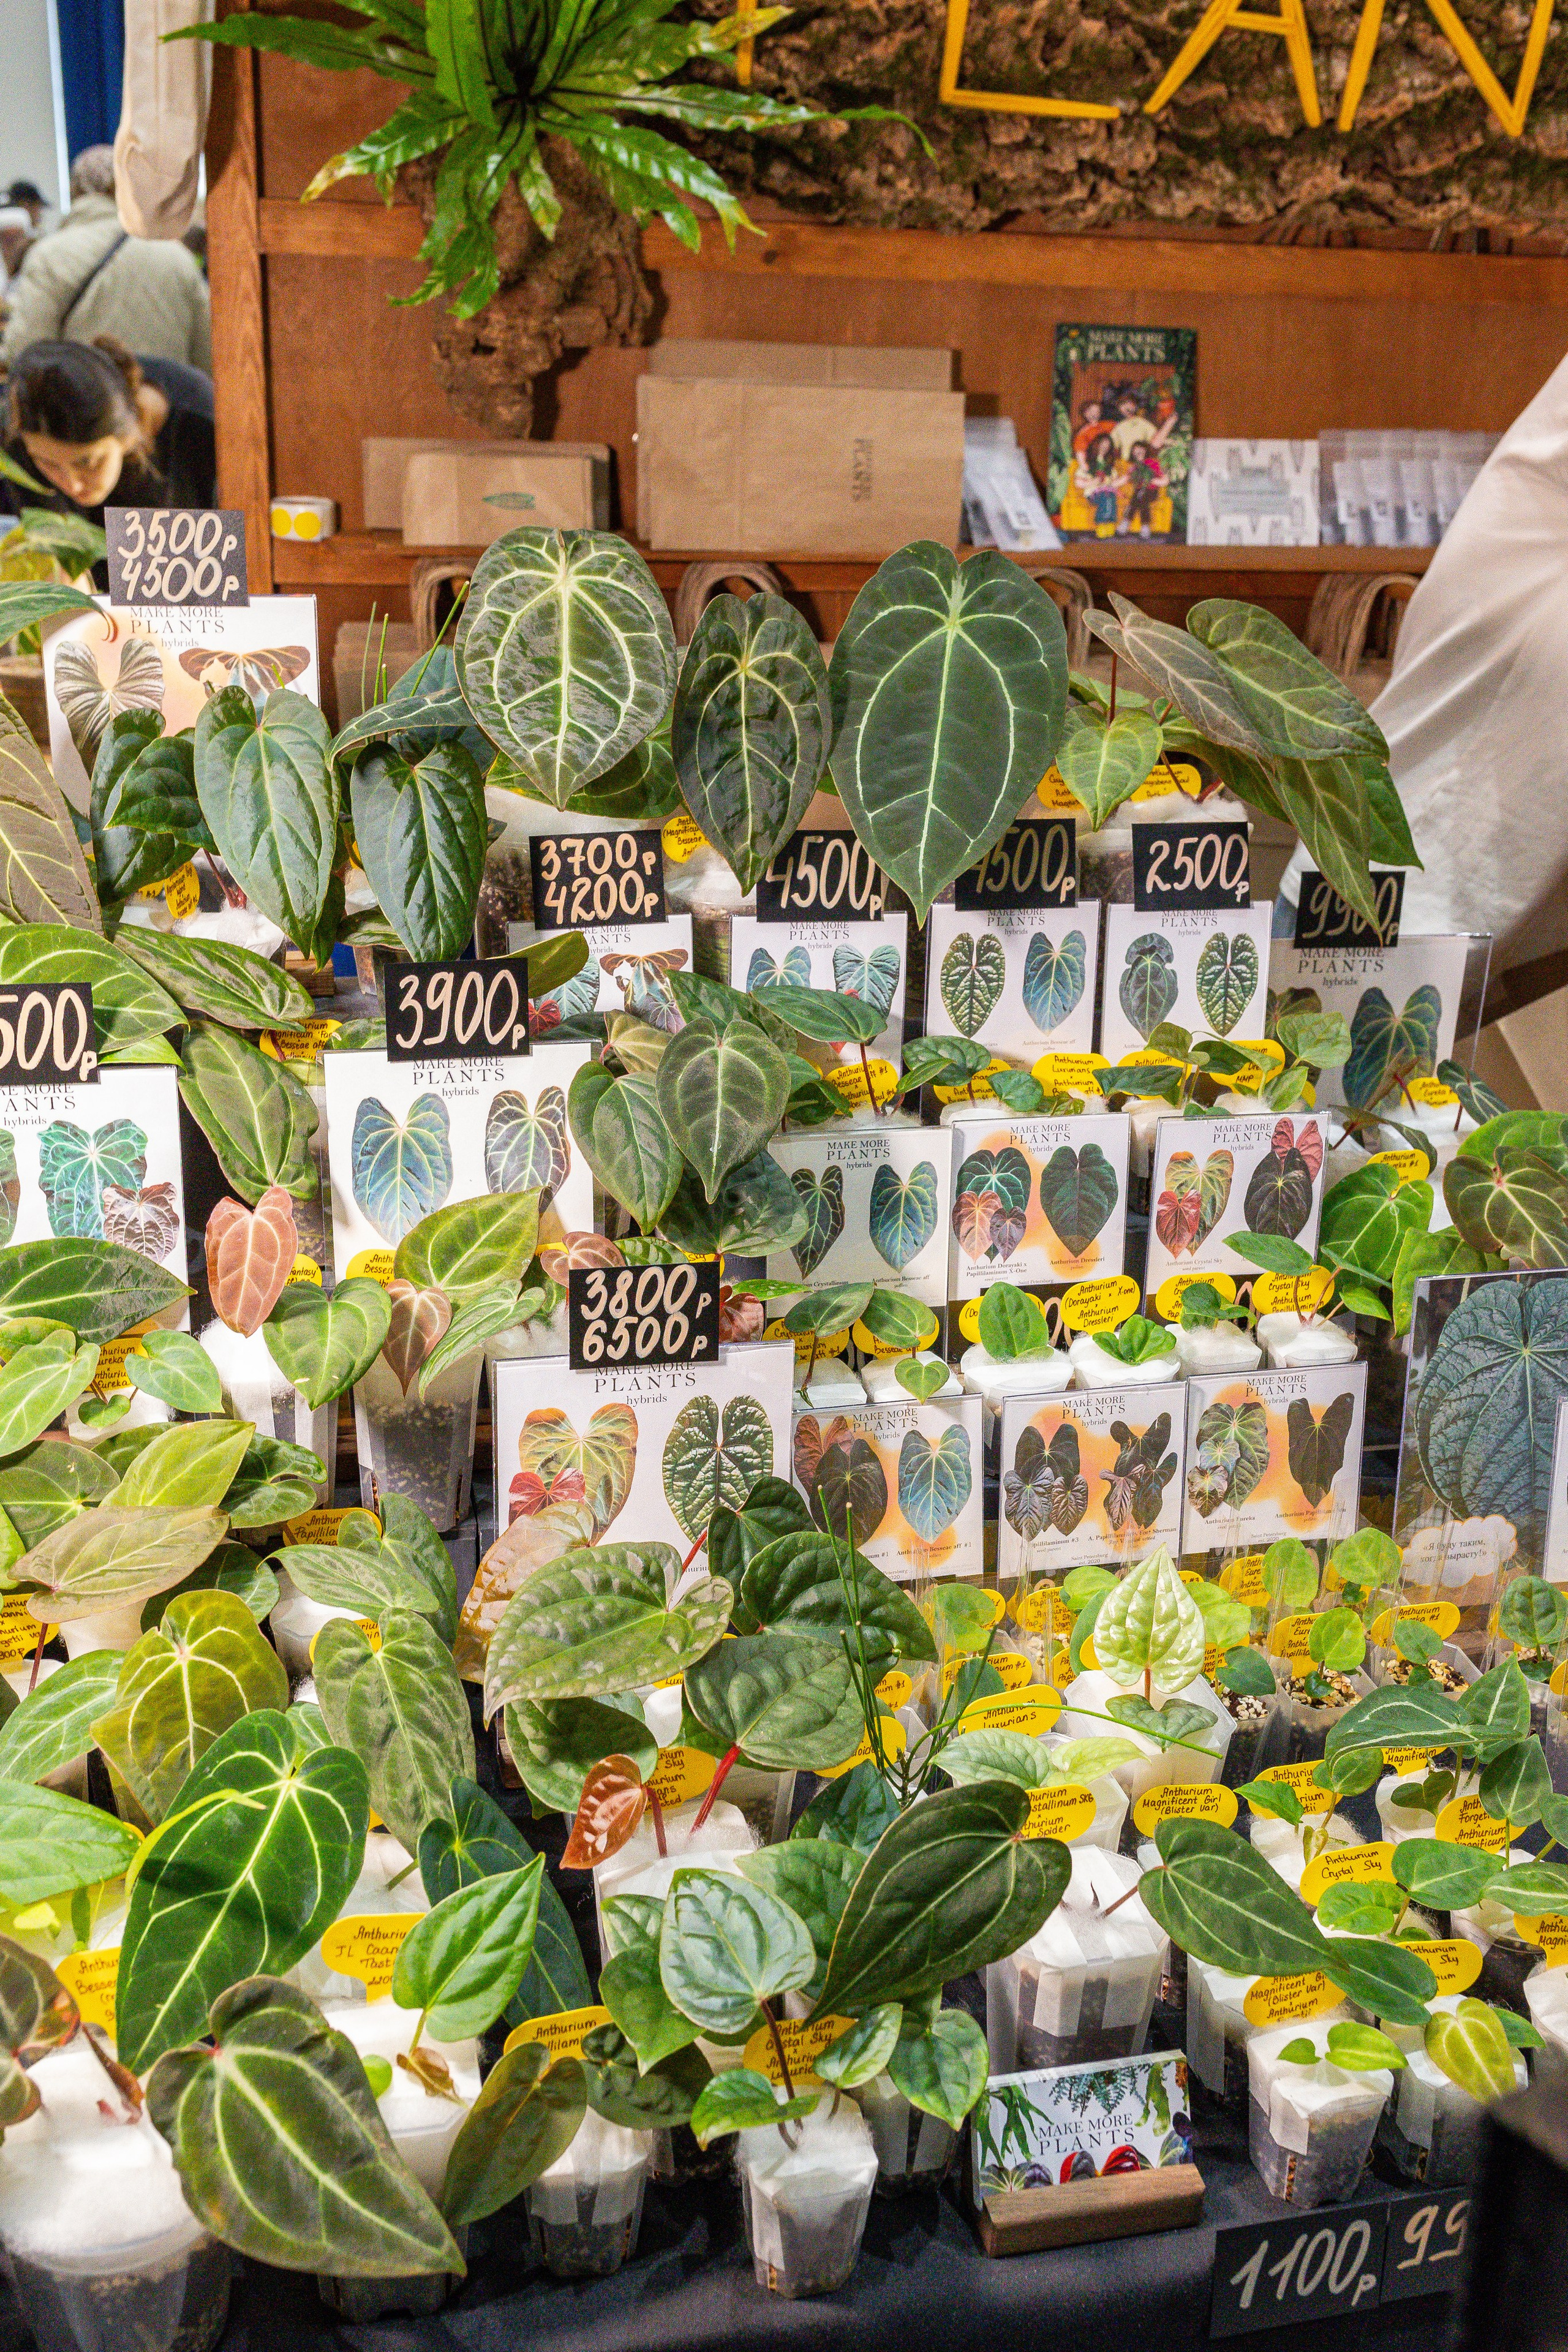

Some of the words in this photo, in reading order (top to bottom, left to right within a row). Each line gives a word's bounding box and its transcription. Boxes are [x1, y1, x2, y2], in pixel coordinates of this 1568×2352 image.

[1087, 345, 1166, 362] PLANTS
[130, 606, 175, 619] MAKE
[179, 606, 223, 619] MORE
[130, 619, 225, 635] PLANTS
[161, 637, 200, 649] hybrids
[987, 908, 1016, 917] MAKE
[1018, 908, 1046, 916] MORE
[1161, 909, 1191, 918] MAKE
[1193, 908, 1218, 917] MORE
[790, 922, 818, 930] MAKE
[821, 921, 850, 930] MORE
[987, 916, 1046, 927] PLANTS
[1161, 916, 1218, 927] PLANTS
[601, 924, 631, 933] MORE
[790, 930, 850, 940] PLANTS
[1004, 928, 1028, 937] hybrids
[1300, 948, 1336, 959] MAKE
[1340, 947, 1385, 957] MORE
[1297, 959, 1384, 974] PLANTS
[413, 1058, 457, 1070] MAKE
[461, 1055, 505, 1067] MORE
[1054, 1055, 1093, 1065] Anthurium
[413, 1069, 506, 1085] PLANTS
[23, 1082, 74, 1095] MORE
[442, 1087, 480, 1099] hybrids
[4, 1115, 47, 1126] hybrids
[1009, 1126, 1038, 1134] MAKE
[1040, 1123, 1071, 1133] MORE
[1009, 1131, 1071, 1145] PLANTS
[1212, 1131, 1272, 1144] PLANTS
[827, 1141, 856, 1150] MAKE
[859, 1139, 891, 1148] MORE
[1028, 1145, 1053, 1154] hybrids
[1230, 1143, 1254, 1152] hybrids
[827, 1148, 890, 1160] PLANTS
[846, 1161, 872, 1170] hybrids
[997, 1262, 1023, 1271] Dorayaki
[1077, 1280, 1117, 1297] Anthurium
[1268, 1283, 1293, 1293] Crystal
[1065, 1292, 1101, 1310] (Dorayaki
[1077, 1305, 1119, 1320] Anthurium
[1083, 1316, 1113, 1327] Dressleri
[594, 1364, 643, 1377] MAKE
[648, 1361, 696, 1373] MORE
[594, 1372, 696, 1393] PLANTS
[1246, 1378, 1276, 1387] MAKE
[1277, 1374, 1307, 1385] MORE
[1245, 1382, 1308, 1398] PLANTS
[625, 1393, 668, 1408] hybrids
[1063, 1399, 1093, 1409] MAKE
[1095, 1395, 1126, 1405] MORE
[1263, 1395, 1289, 1405] hybrids
[853, 1412, 884, 1422] MAKE
[886, 1408, 918, 1418] MORE
[1062, 1404, 1126, 1419] PLANTS
[853, 1417, 919, 1433] PLANTS
[1082, 1419, 1107, 1428] hybrids
[873, 1431, 900, 1441] hybrids
[1160, 1787, 1213, 1800] Anthurium
[1142, 1797, 1197, 1811] Magnificent
[1204, 1793, 1221, 1804] Girl
[1161, 1805, 1194, 1815] (Blister
[1325, 1850, 1379, 1866] Anthurium
[1321, 1866, 1354, 1880] Crystal
[1038, 2119, 1085, 2139] MAKE
[1088, 2113, 1134, 2132] MORE
[1038, 2127, 1135, 2157] PLANTS
